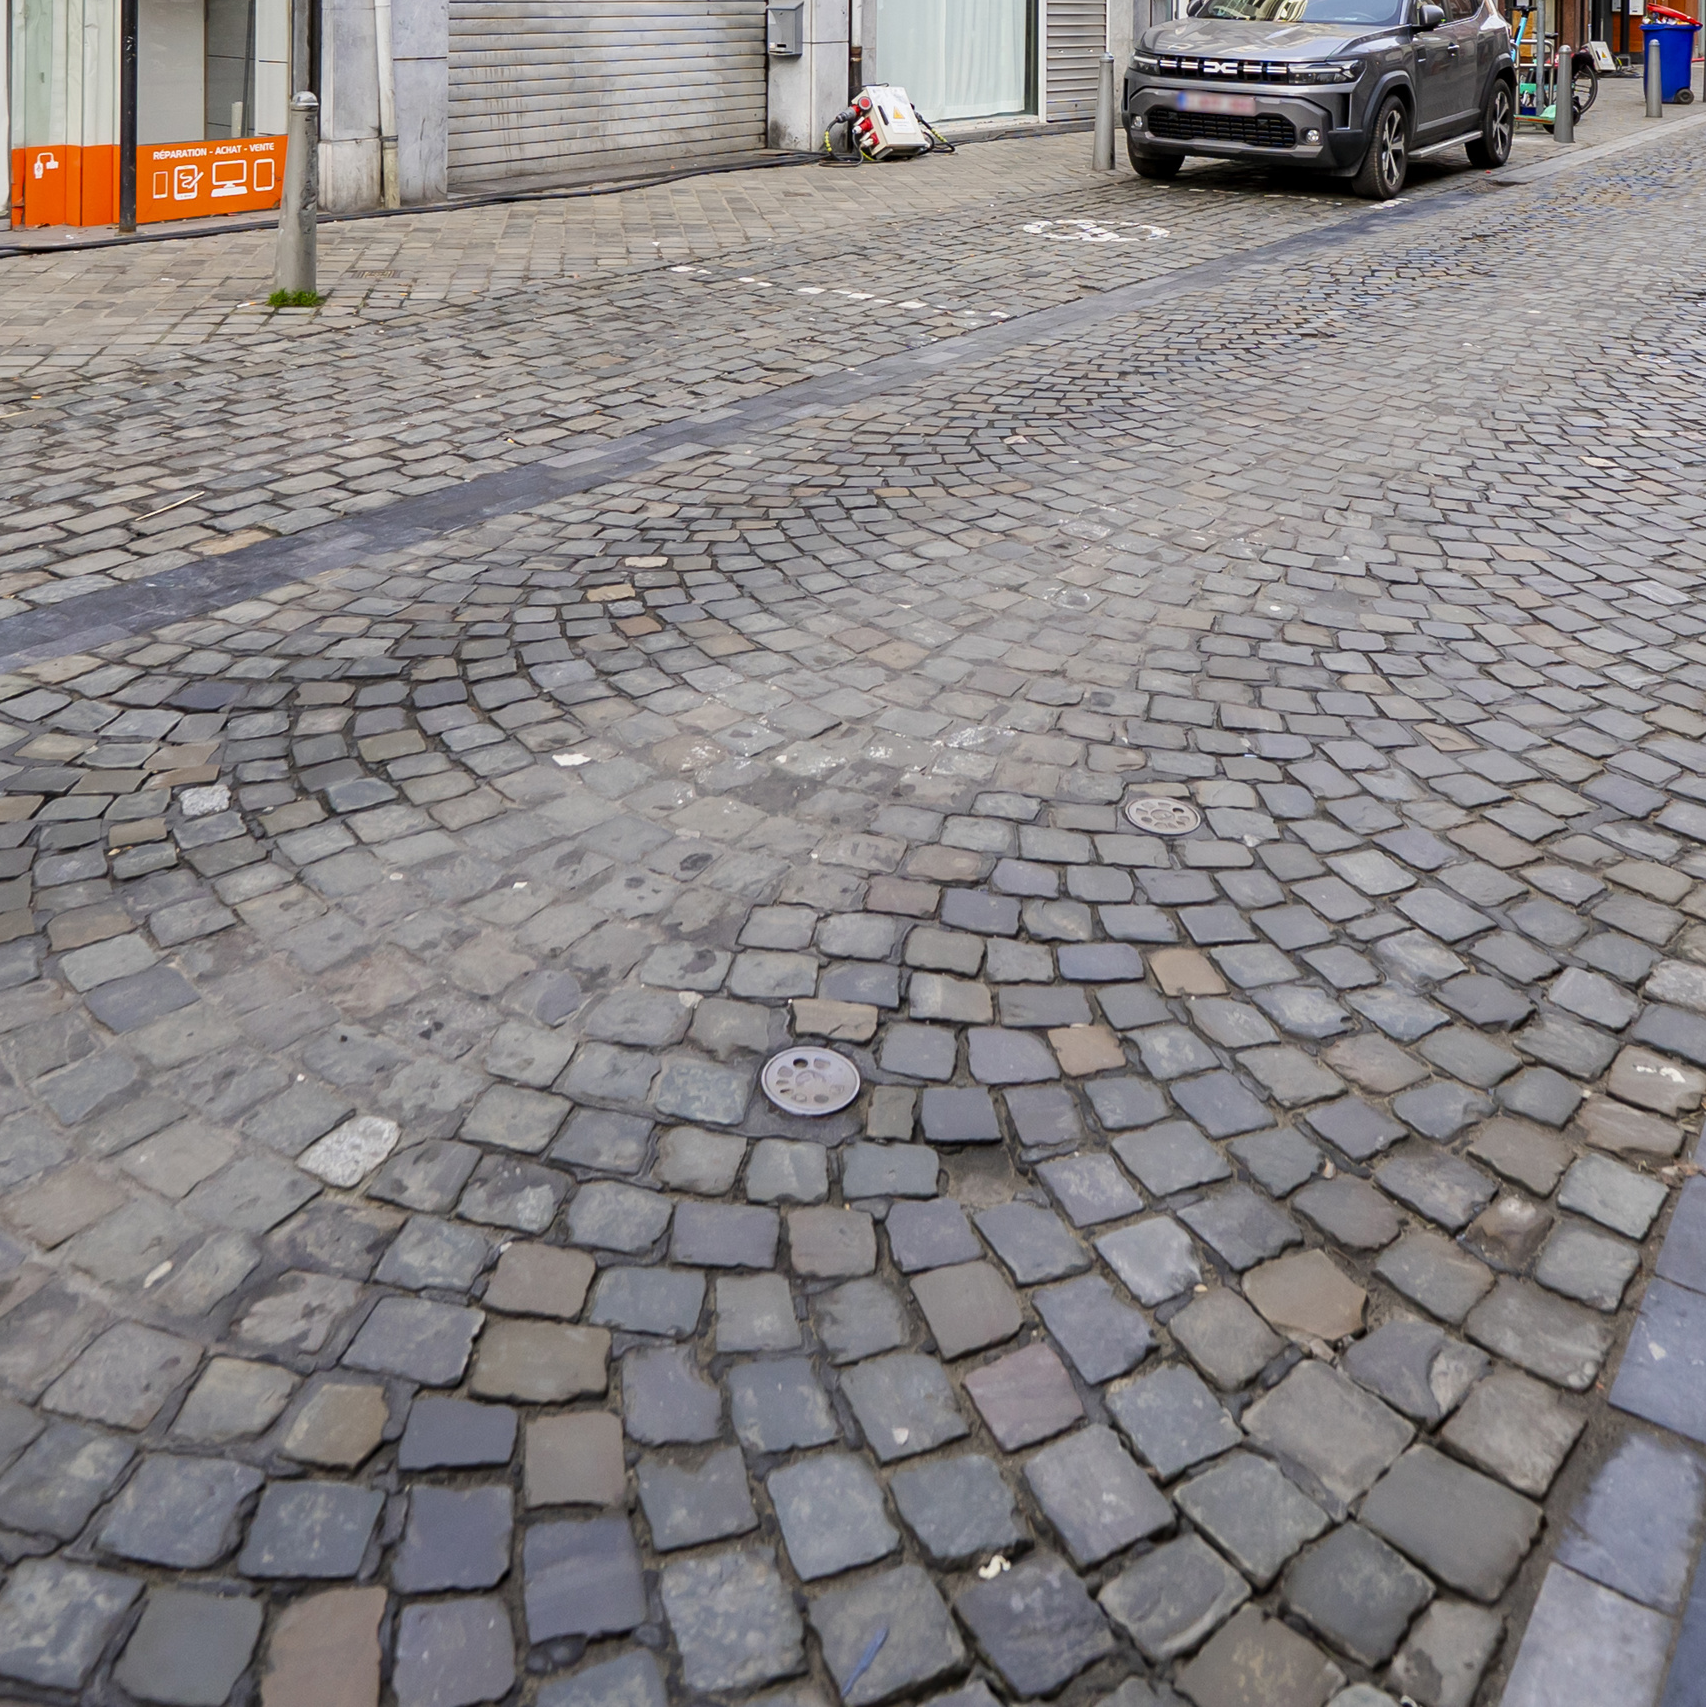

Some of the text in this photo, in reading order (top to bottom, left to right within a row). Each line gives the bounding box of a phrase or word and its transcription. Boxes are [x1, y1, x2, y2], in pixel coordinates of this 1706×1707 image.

[153, 148, 207, 160] RÉPARATION
[215, 145, 241, 155] ACHAT
[249, 143, 274, 152] VENTE
